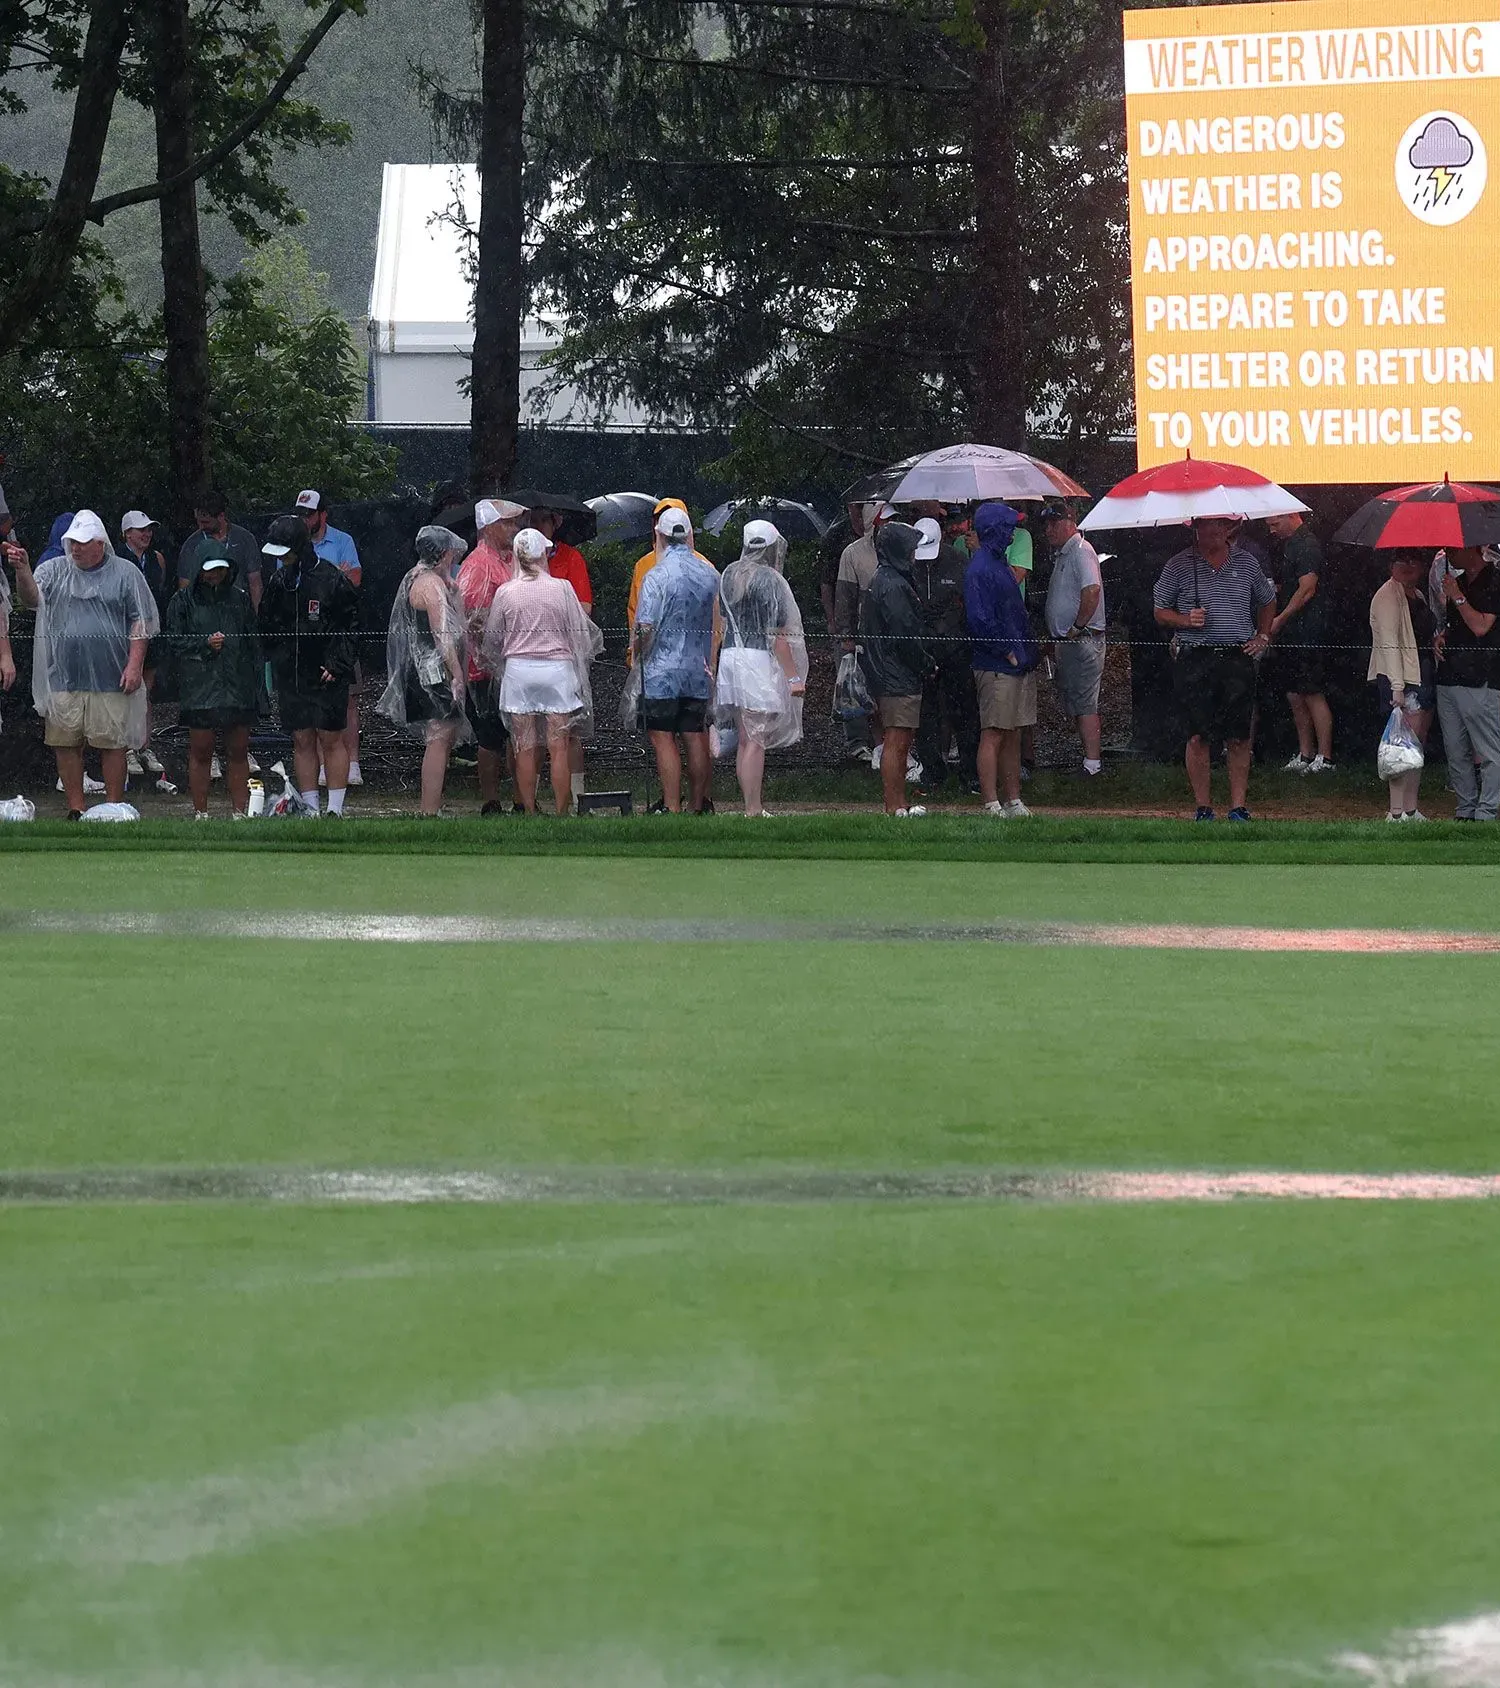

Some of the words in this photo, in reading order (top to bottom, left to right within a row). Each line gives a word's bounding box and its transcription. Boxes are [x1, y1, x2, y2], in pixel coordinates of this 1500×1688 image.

[1147, 36, 1306, 88] WEATHER
[1315, 26, 1484, 80] WARNING
[1139, 111, 1345, 156] DANGEROUS
[1140, 173, 1302, 214] WEATHER
[1310, 171, 1343, 209] IS
[1143, 230, 1395, 273] APPROACHING.
[1145, 292, 1294, 332] PREPARE
[1303, 290, 1348, 327] TO
[1356, 287, 1445, 326] TAKE
[1146, 351, 1290, 390] SHELTER
[1298, 349, 1346, 386] OR
[1355, 346, 1494, 385] RETURN
[1148, 411, 1192, 448] TO
[1200, 410, 1290, 447] YOUR
[1299, 406, 1473, 445] VEHICLES.
